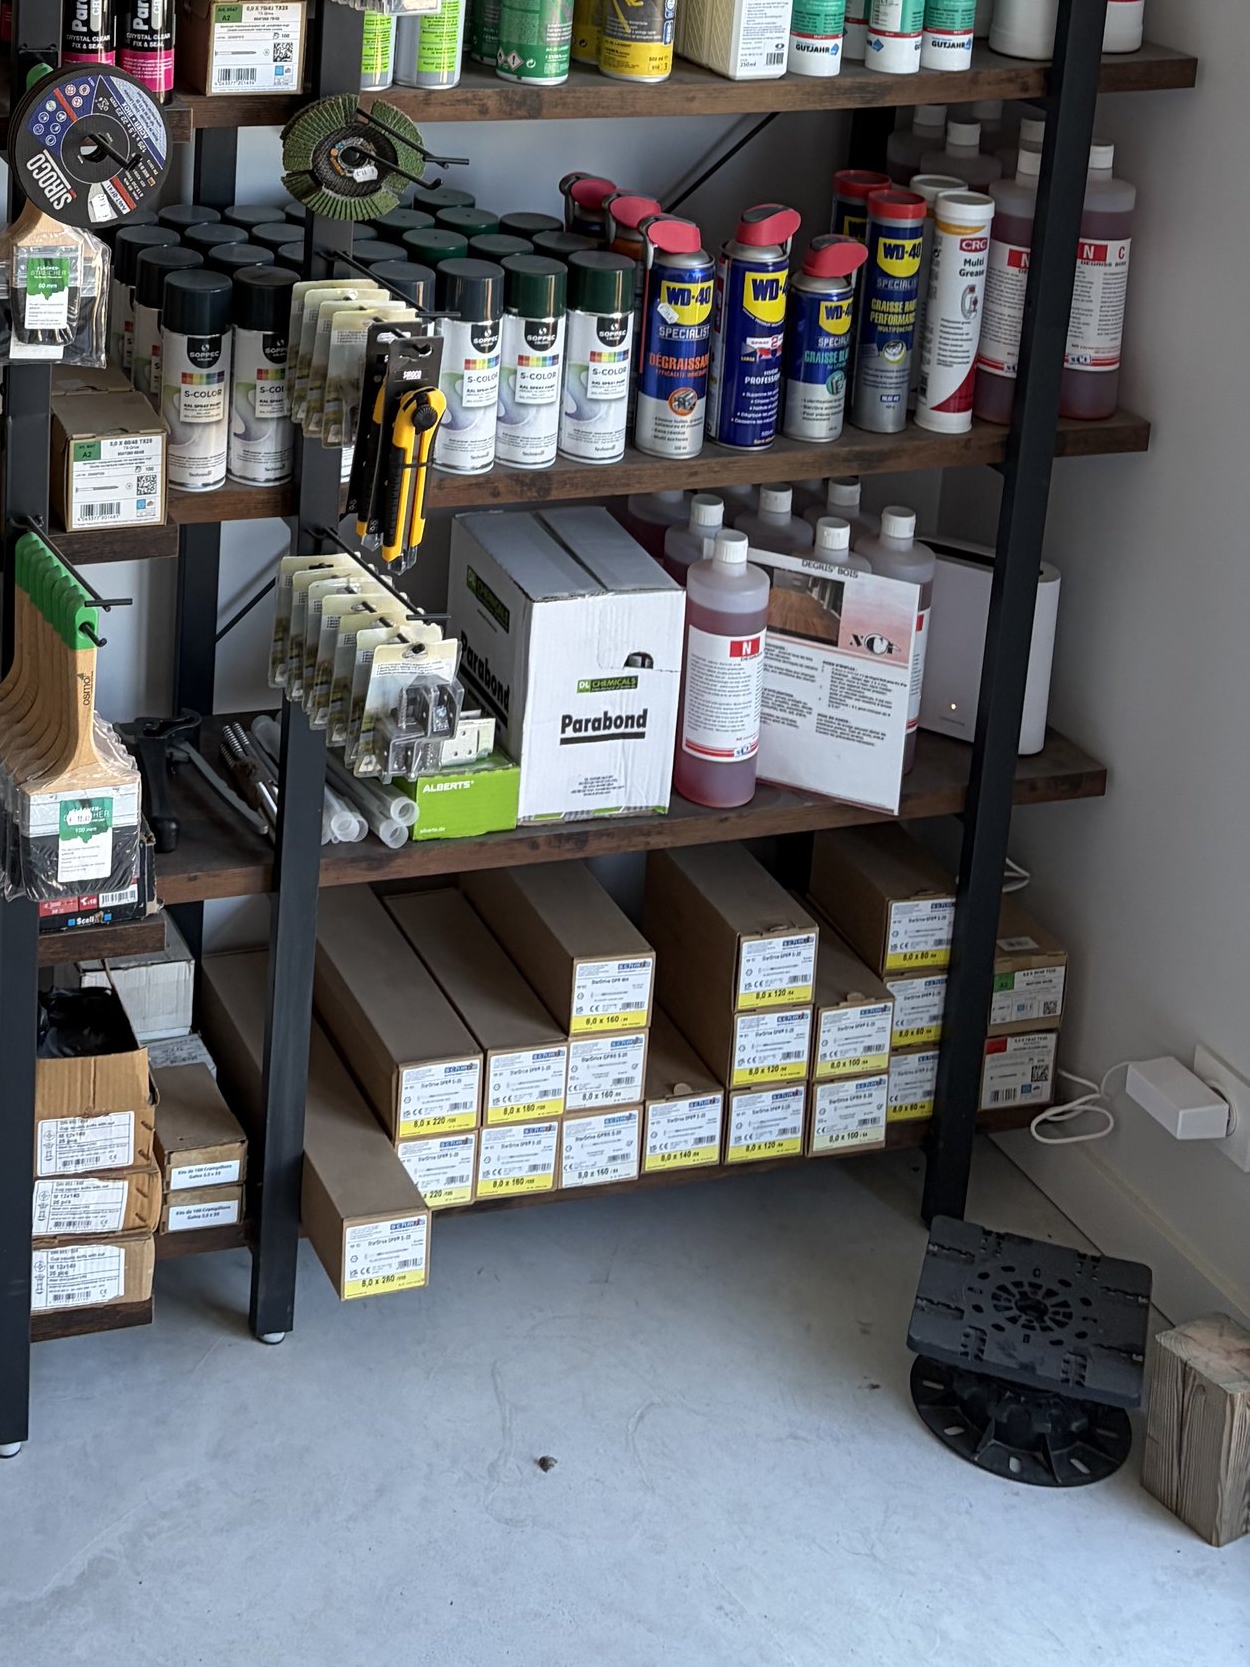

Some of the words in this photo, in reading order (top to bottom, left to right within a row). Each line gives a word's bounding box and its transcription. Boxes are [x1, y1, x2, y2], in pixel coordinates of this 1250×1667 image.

[796, 43, 830, 53] GUTJAHR
[26, 153, 72, 210] SIROCO
[883, 242, 921, 260] WD-40
[961, 239, 987, 251] CRC
[1083, 245, 1095, 259] N
[1118, 246, 1125, 260] C
[964, 258, 984, 268] Multi
[959, 268, 985, 277] Grease
[666, 286, 711, 306] WD-40
[659, 326, 709, 339] SPECIALIST
[805, 350, 837, 363] GRAISSE
[521, 372, 556, 380] S-COLOR
[184, 389, 222, 398] S-COLOR
[837, 567, 858, 579] BOIS
[742, 641, 752, 654] N
[461, 631, 510, 714] Parabond
[579, 680, 590, 690] DL
[592, 677, 637, 688] CHEMICALS
[561, 708, 648, 734] Parabond
[755, 991, 766, 1000] 8,0
[774, 989, 786, 997] 120
[586, 1017, 597, 1026] 8,0
[606, 1015, 619, 1024] 160
[433, 1117, 446, 1125] 220
